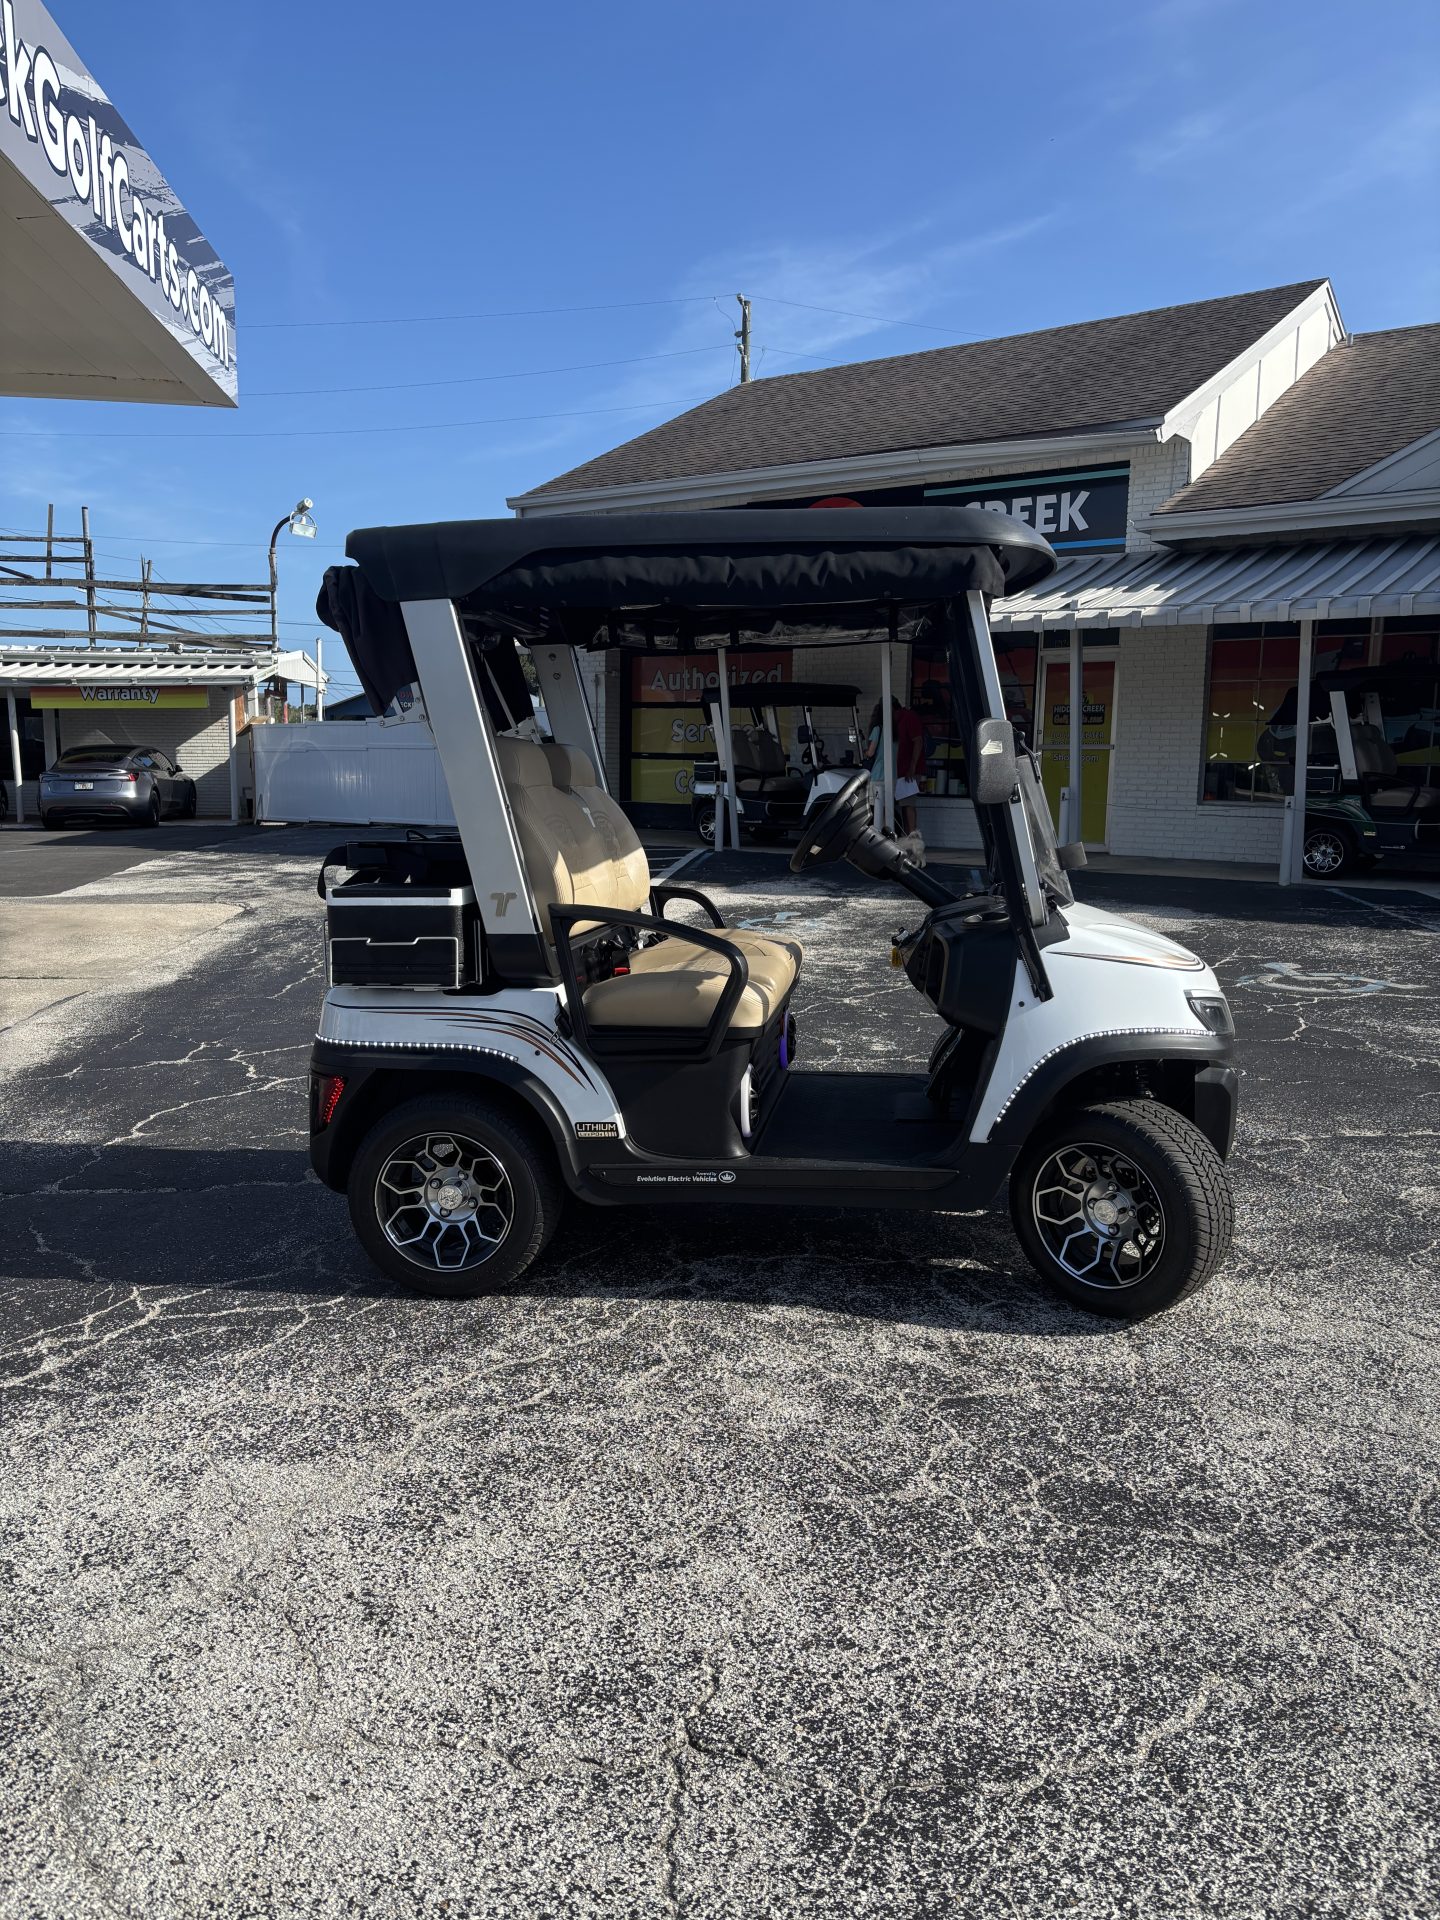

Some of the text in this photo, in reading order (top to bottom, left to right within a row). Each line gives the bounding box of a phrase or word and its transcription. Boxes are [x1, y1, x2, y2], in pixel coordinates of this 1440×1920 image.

[0, 0, 230, 370] kGolfCarts.com
[964, 490, 1091, 534] EEK
[650, 663, 783, 691] Authoized
[80, 686, 160, 704] Warranty
[576, 1123, 616, 1131] LITHIUM
